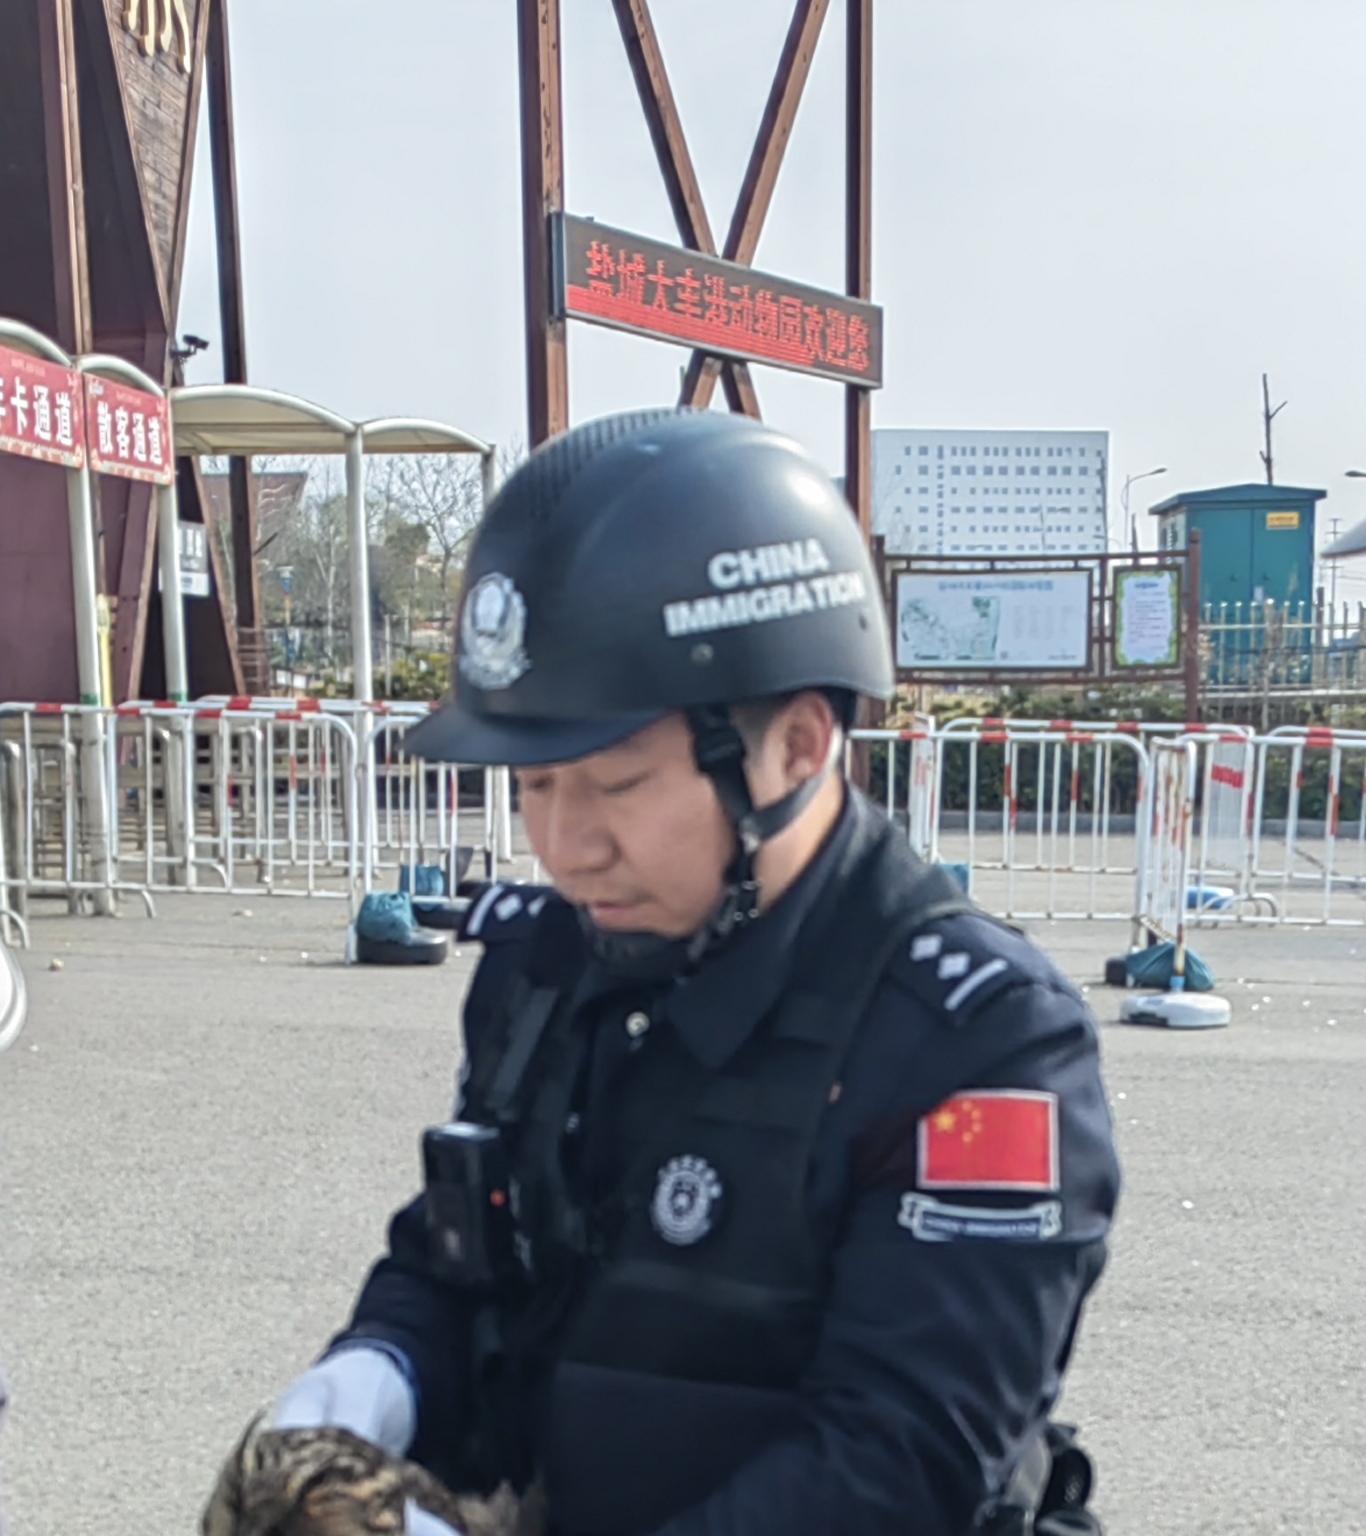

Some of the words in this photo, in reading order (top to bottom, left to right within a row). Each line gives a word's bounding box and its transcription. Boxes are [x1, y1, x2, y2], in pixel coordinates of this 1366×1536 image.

[97, 401, 163, 465] 散客通道
[708, 537, 830, 589] CHINA
[663, 570, 865, 637] IMMIGRATION
